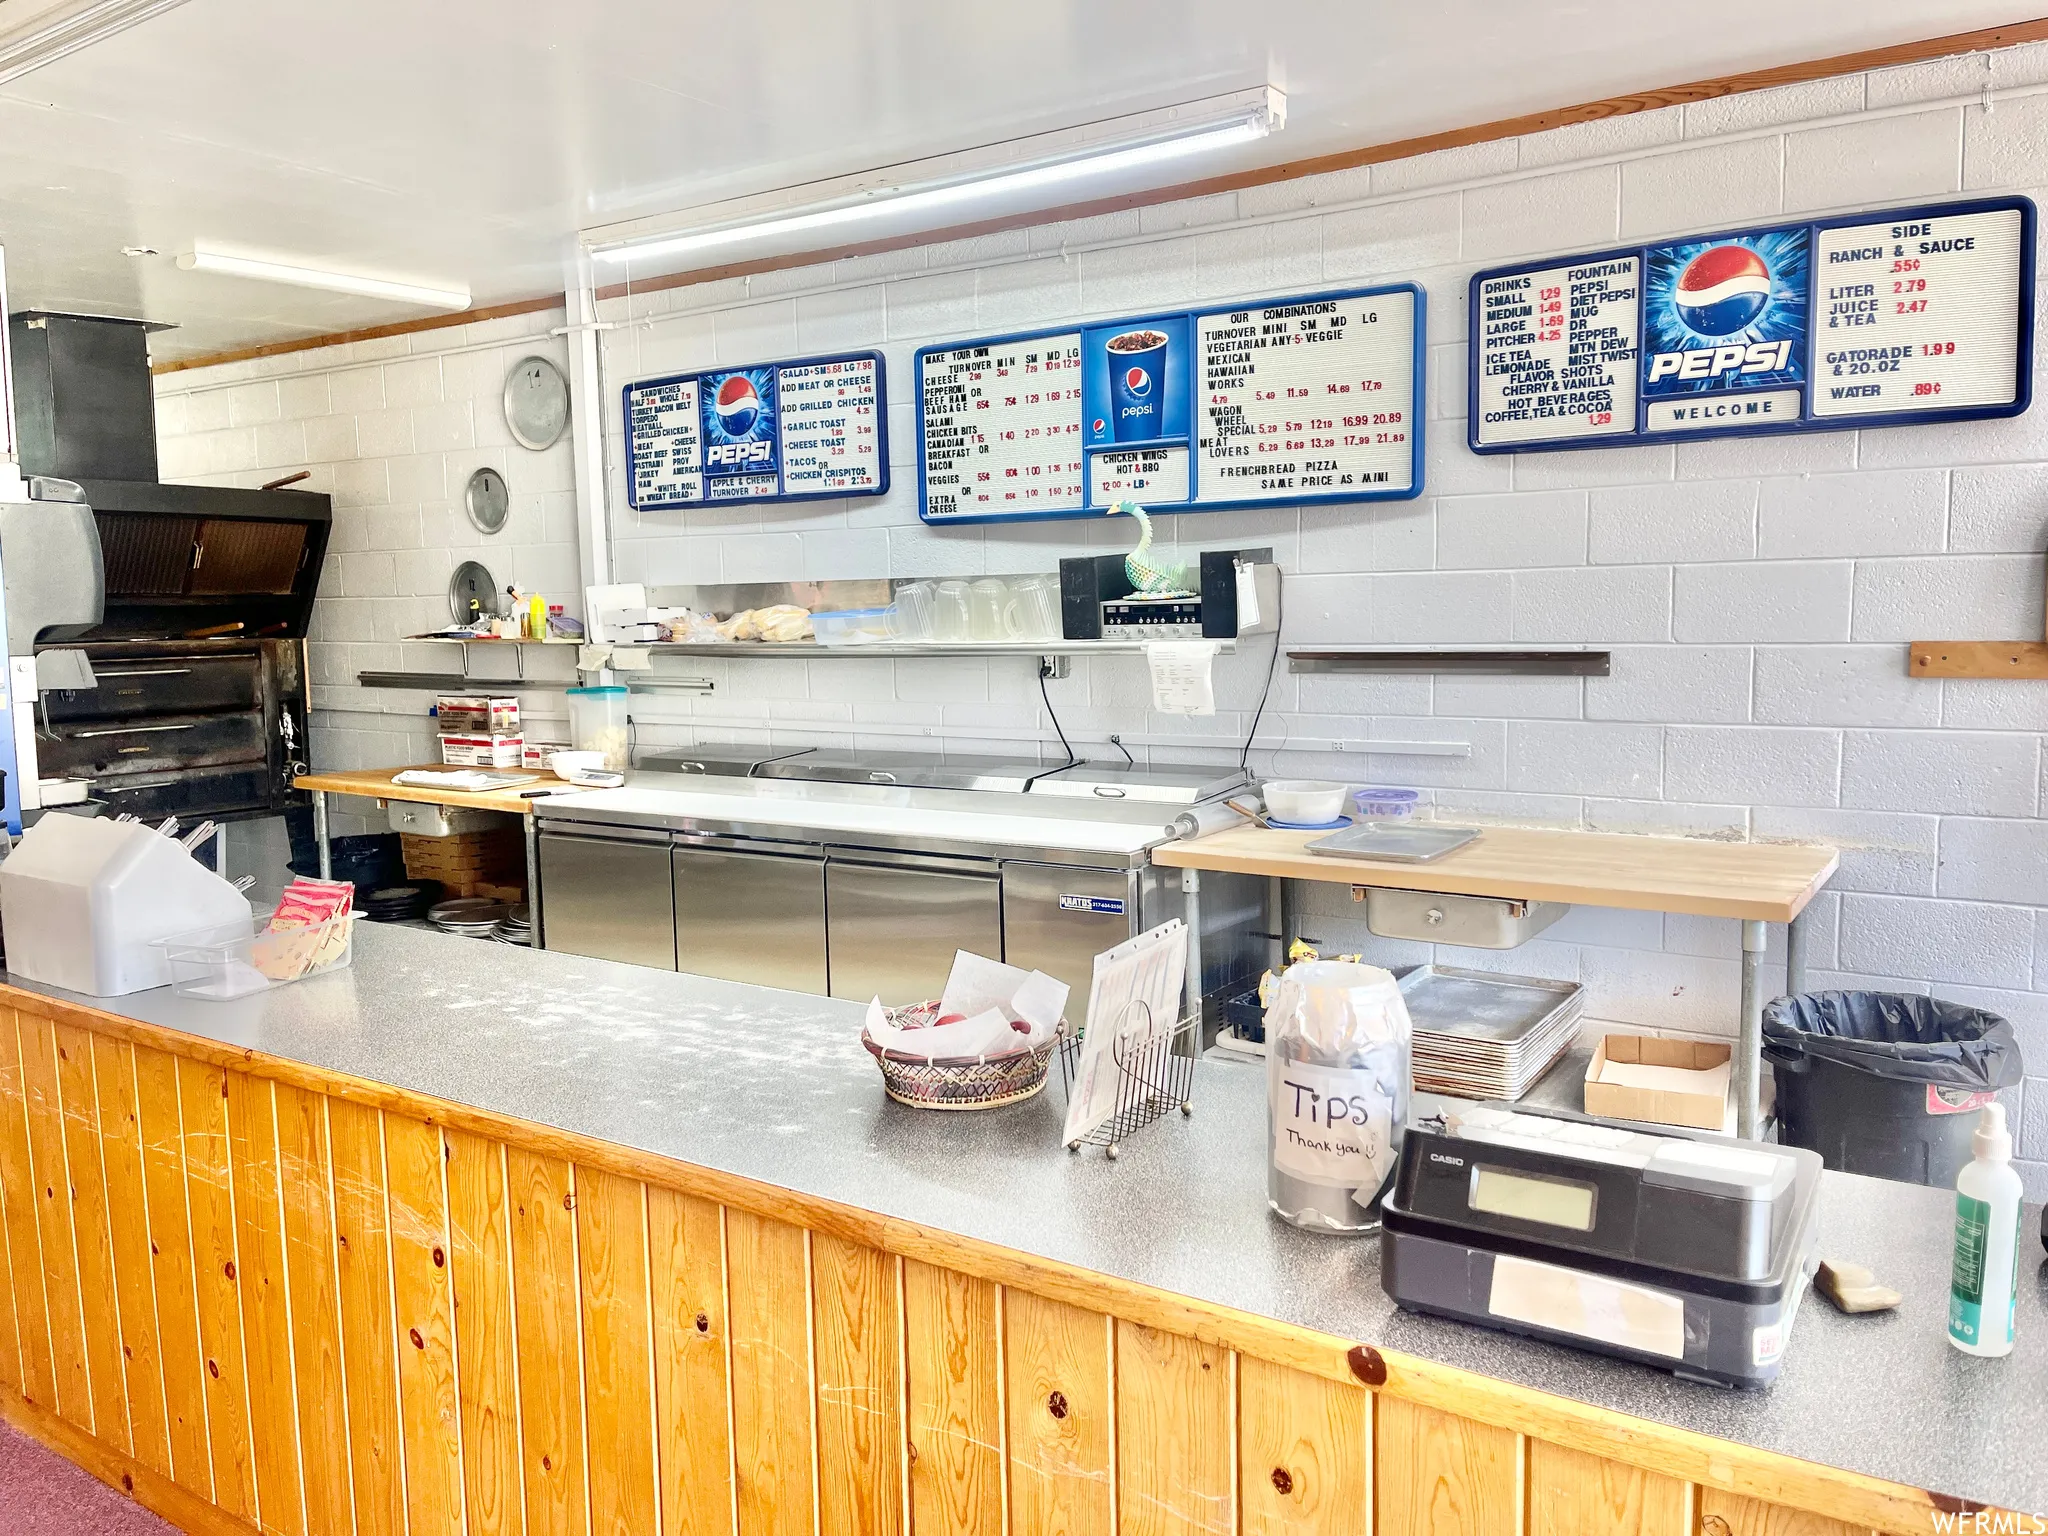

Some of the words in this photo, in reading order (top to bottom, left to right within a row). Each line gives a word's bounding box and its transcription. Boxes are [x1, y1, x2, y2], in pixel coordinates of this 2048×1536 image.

[1892, 224, 1931, 238] SIDE
[1830, 247, 1883, 263] RANCH
[1894, 245, 1904, 256] &
[1919, 238, 1975, 254] SAUCE
[1568, 262, 1631, 281] FOUNTAIN
[1485, 278, 1531, 294] DRINKS
[1571, 280, 1608, 295] PEPSI
[1830, 285, 1874, 299] LITER
[1486, 293, 1526, 307] SMALL
[1570, 294, 1596, 307] DIET
[1599, 288, 1635, 303] PEPSI
[1231, 313, 1249, 324] OUR
[1264, 302, 1337, 320] COMBINATIONS
[1487, 305, 1532, 321] MEDIUM
[1570, 306, 1598, 319] MUG
[1830, 300, 1879, 315] JUICE
[1205, 327, 1256, 341] TURNOVER
[1263, 323, 1287, 335] MINI
[1300, 319, 1316, 330] SM
[1331, 317, 1346, 327] MD
[1362, 313, 1377, 324] LG
[1569, 319, 1587, 330] DR
[1829, 317, 1838, 328] &
[1845, 313, 1876, 327] TEA
[1487, 320, 1526, 335] LARGE
[1487, 333, 1535, 349] PITCHER
[1569, 327, 1618, 342] PEPPER
[1207, 338, 1267, 353] VEGETARIAN
[1306, 330, 1343, 343] VEGGIE
[1569, 342, 1596, 354] MTN
[1601, 337, 1628, 350] DEW
[925, 354, 945, 364] MAKE
[952, 351, 971, 361] YOUR
[974, 348, 989, 358] OWN
[949, 361, 992, 374] TURNOVER
[997, 357, 1015, 367] MIN
[1025, 354, 1037, 363] SM
[1047, 351, 1060, 360] MD
[1067, 348, 1079, 357] LG
[1208, 353, 1250, 365] MEXICAN
[1487, 353, 1505, 364] ICE
[1509, 350, 1531, 361] TEA
[1569, 353, 1599, 366] MIST
[1601, 348, 1637, 362] TWIST
[1648, 340, 1793, 382] PEPSI
[1827, 346, 1913, 363] GATORADE
[783, 369, 809, 378] SALAD
[845, 364, 854, 372] LG
[1208, 365, 1255, 378] HAWAIIAN
[1486, 359, 1550, 375] LEMONADE
[1833, 365, 1843, 376] &
[925, 374, 958, 386] CHEESE
[1510, 370, 1554, 384] FLAVOR
[1561, 364, 1603, 378] SHOTS
[781, 384, 796, 392] ADD
[798, 381, 820, 390] MEAT
[824, 380, 834, 388] OR
[838, 376, 871, 386] CHEESE
[1208, 378, 1244, 390] WORKS
[1503, 382, 1548, 396] CHERRY
[1552, 381, 1559, 391] &
[1563, 375, 1614, 390] VANILLA
[641, 385, 680, 398] SANDWICHES
[925, 385, 965, 397] PEPPERONI
[971, 388, 982, 397] OR
[1831, 385, 1881, 399] WATER
[781, 404, 797, 412] ADD
[800, 401, 832, 411] GRILLED
[838, 397, 874, 407] CHICKEN
[925, 396, 944, 406] BEEF
[949, 393, 967, 403] HAM
[1508, 398, 1532, 409] HOT
[925, 403, 968, 415] SAUSAGE
[1122, 403, 1153, 418] pepsi
[1209, 406, 1242, 416] WAGON
[1558, 406, 1566, 415] &
[1568, 402, 1612, 415] COCOA
[1674, 401, 1772, 420] WELCOME
[788, 422, 817, 431] GARLIC
[820, 419, 845, 428] TOAST
[926, 417, 953, 428] SALAMI
[1215, 416, 1246, 426] WHEEL
[663, 426, 688, 436] CHICKEN
[927, 429, 958, 439] CHICKEN
[961, 426, 977, 435] BITS
[1217, 426, 1256, 437] SPECIAL
[675, 437, 696, 446] CHEESE
[789, 440, 817, 449] CHEESE
[821, 438, 845, 447] TOAST
[927, 438, 964, 449] CANADIAN
[1200, 437, 1228, 448] MEAT
[708, 441, 771, 465] PEPSI
[928, 448, 970, 460] BREAKFAST
[979, 445, 989, 453] OR
[1103, 452, 1138, 463] CHICKEN
[1142, 450, 1168, 461] WINGS
[1210, 446, 1250, 457] LOVERS
[790, 458, 816, 466] TACOS
[928, 461, 953, 471] BACON
[1117, 464, 1132, 474] HOT
[1135, 464, 1140, 472] &
[1142, 463, 1159, 472] BBQ
[790, 471, 822, 480] CHICKEN
[826, 468, 866, 478] CRISPITOS
[1220, 464, 1295, 477] FRENCHBREAD
[1306, 461, 1338, 471] PIZZA
[682, 482, 697, 490] ROLL
[713, 479, 734, 487] APPLE
[747, 475, 775, 484] CHERRY
[928, 475, 959, 485] VEGGIES
[1133, 479, 1144, 488] LB
[1262, 479, 1294, 489] SAME
[1301, 476, 1333, 486] PRICE
[1341, 474, 1352, 484] AS
[1362, 473, 1388, 483] MINI
[713, 488, 748, 497] TURNOVER
[962, 487, 971, 495] OR
[929, 495, 955, 505] EXTRA
[929, 504, 957, 514] CHEESE
[1284, 1080, 1368, 1129] Tips
[1286, 1128, 1331, 1152] Thank
[1336, 1142, 1360, 1156] you
[1430, 1153, 1463, 1166] CASIO
